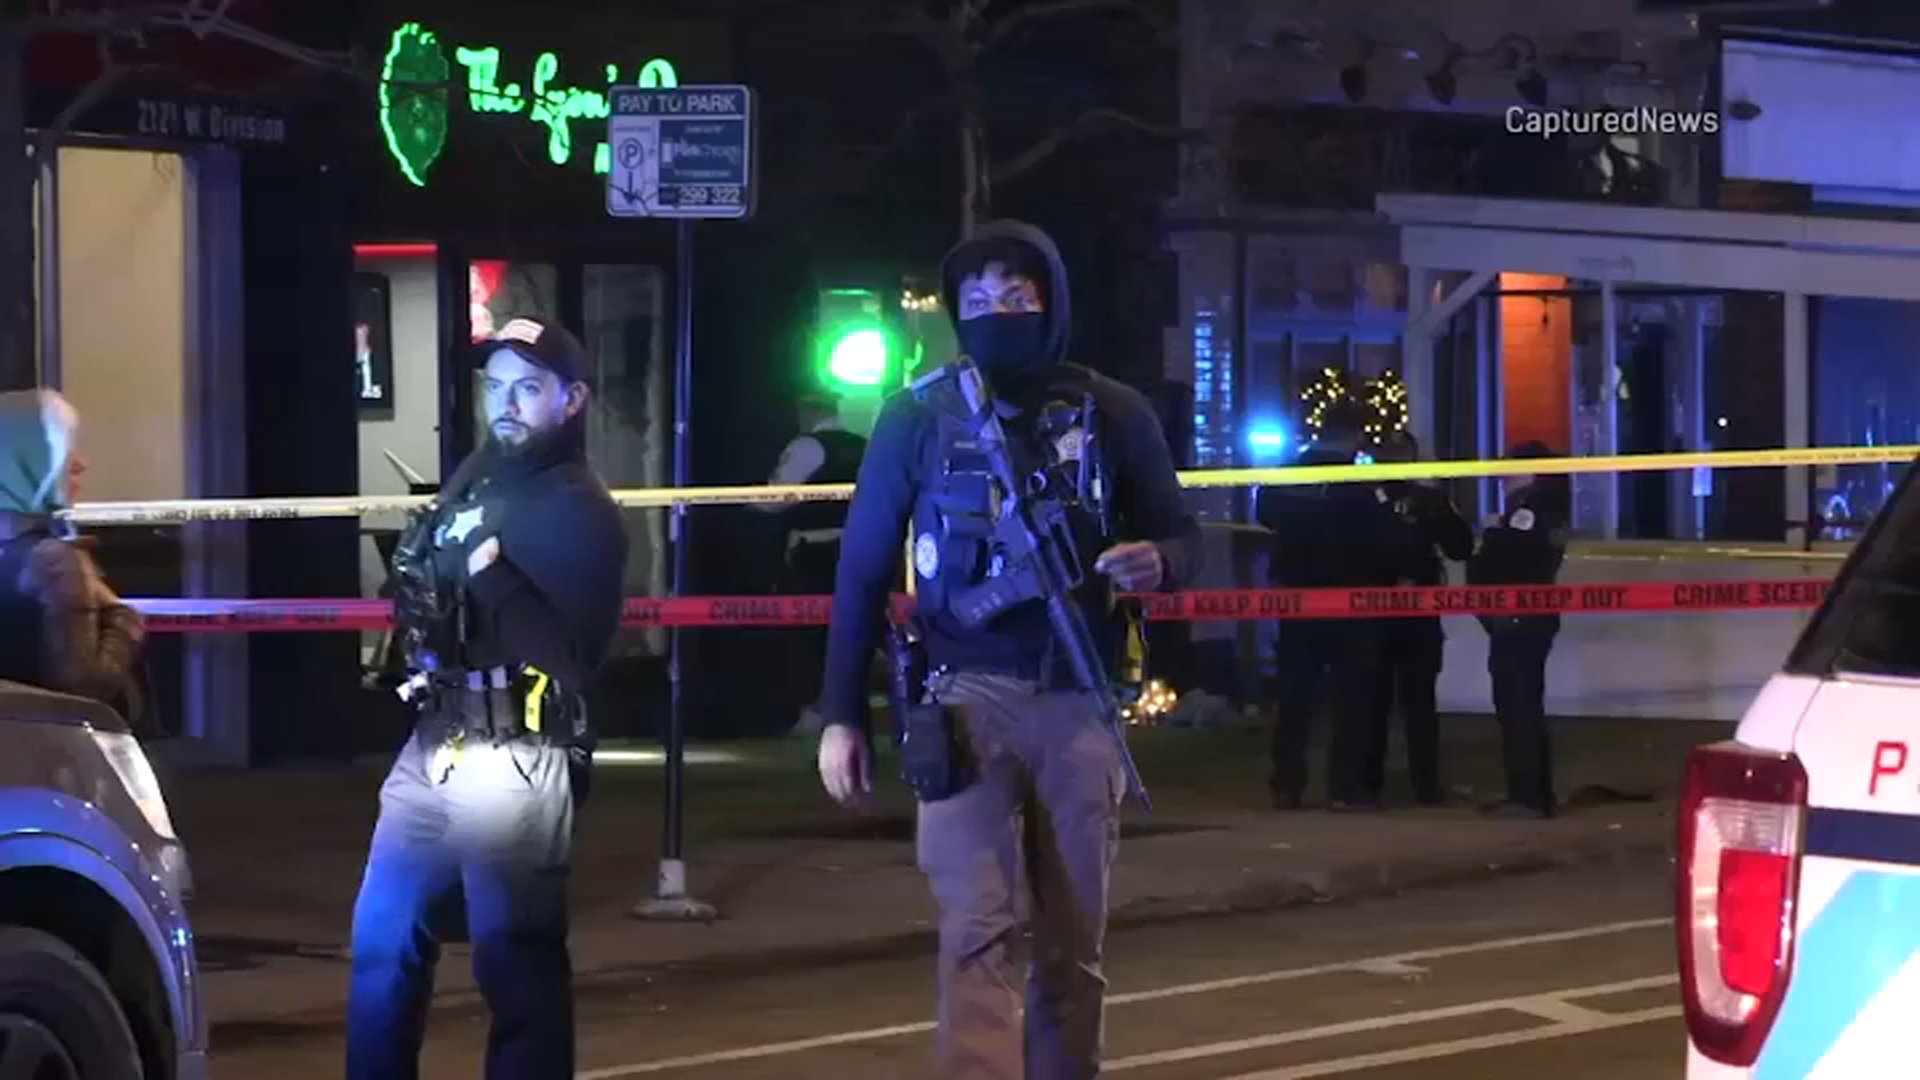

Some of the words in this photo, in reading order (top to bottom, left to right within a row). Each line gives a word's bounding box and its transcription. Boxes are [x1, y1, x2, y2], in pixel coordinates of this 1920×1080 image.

[456, 47, 525, 113] The
[530, 52, 618, 165] Lyon'
[618, 94, 652, 113] PAY
[657, 94, 683, 113] TO
[687, 94, 736, 113] PARK
[1193, 592, 1251, 615] KEEP
[1260, 592, 1303, 614] OUT
[1349, 591, 1425, 612] CRIME
[1432, 589, 1505, 611] SCENE
[1515, 587, 1573, 609] KEEP
[1582, 587, 1628, 609] OUT
[1673, 583, 1750, 607] CRIME
